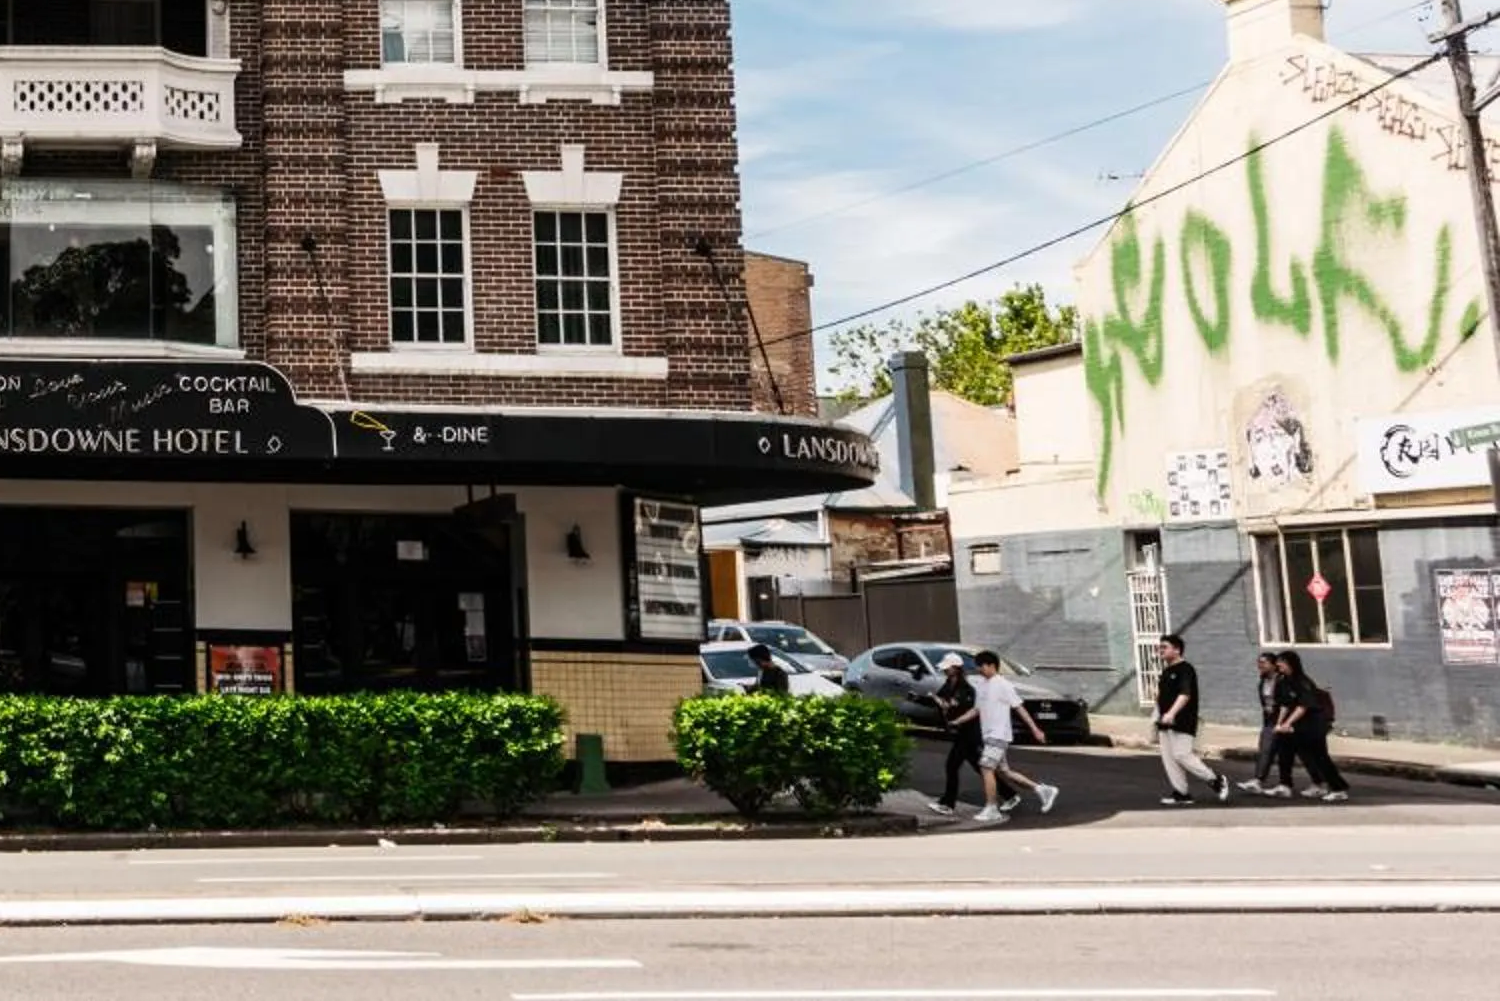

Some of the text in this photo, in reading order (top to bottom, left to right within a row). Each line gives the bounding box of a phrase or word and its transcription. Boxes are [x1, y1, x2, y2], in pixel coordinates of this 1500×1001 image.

[179, 376, 276, 393] COCKTAIL
[209, 399, 250, 414] BAR
[153, 428, 249, 454] HOTEL
[443, 426, 489, 443] DINE
